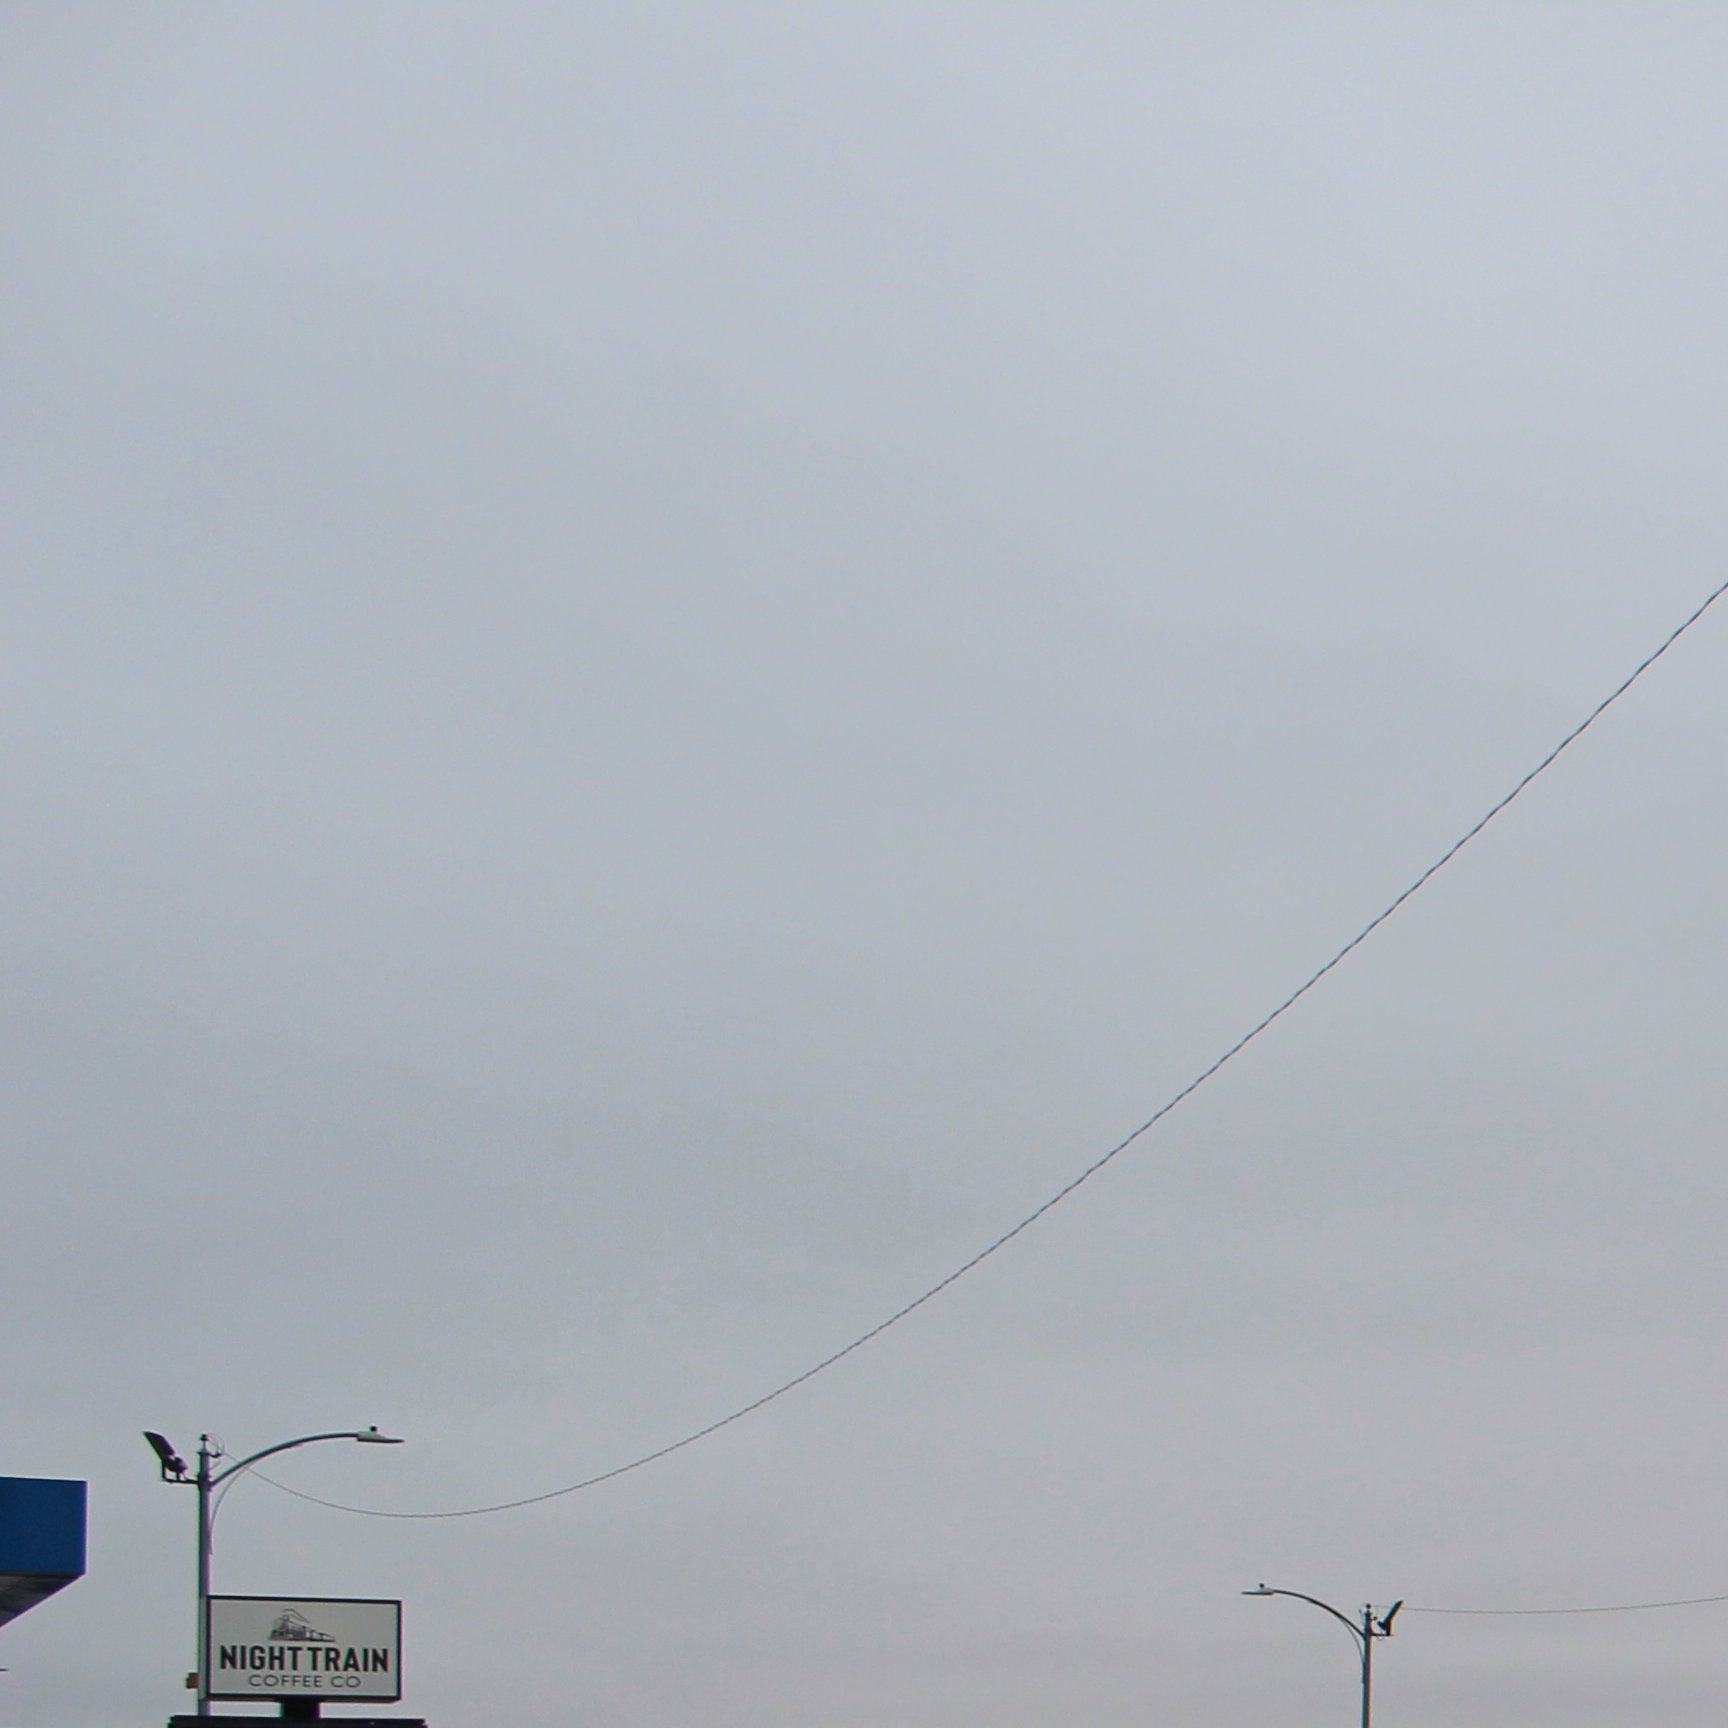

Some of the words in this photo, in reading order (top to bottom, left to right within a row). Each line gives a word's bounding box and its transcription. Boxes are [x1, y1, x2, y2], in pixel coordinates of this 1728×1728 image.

[220, 1645, 304, 1671] NIGHT
[306, 1647, 389, 1673] TRAIN
[248, 1674, 323, 1688] COFFEE
[330, 1675, 362, 1689] CO
